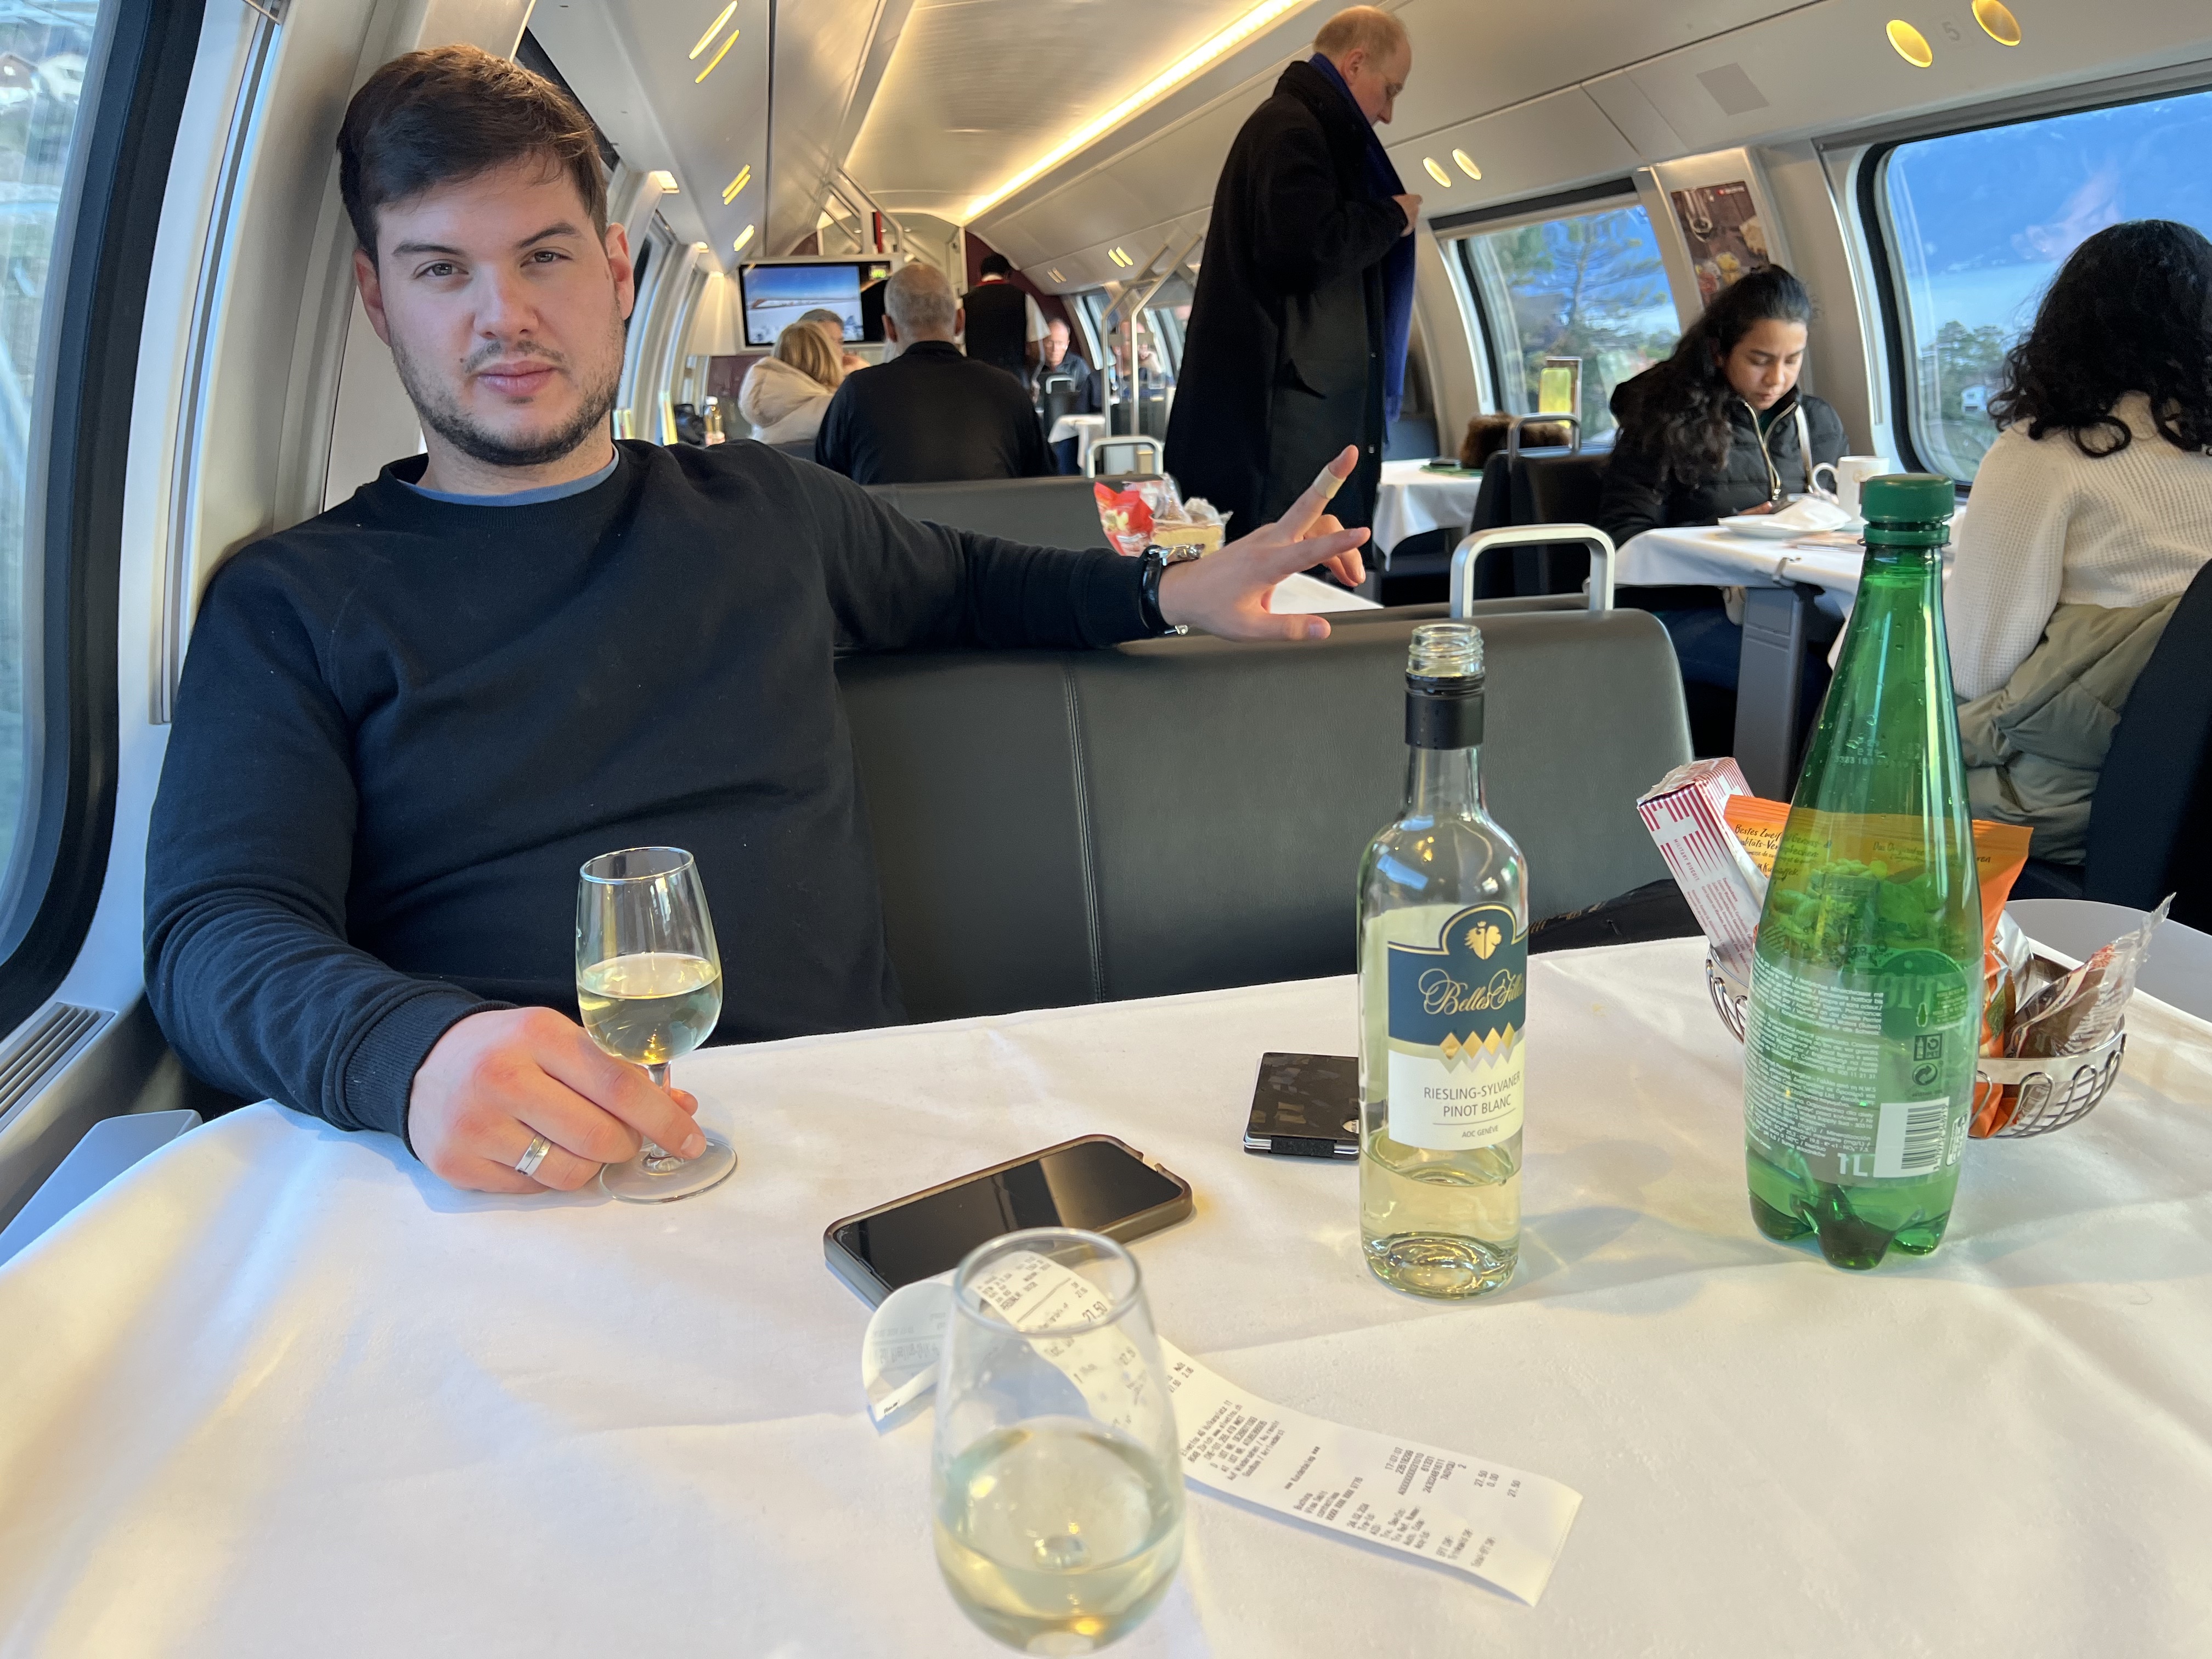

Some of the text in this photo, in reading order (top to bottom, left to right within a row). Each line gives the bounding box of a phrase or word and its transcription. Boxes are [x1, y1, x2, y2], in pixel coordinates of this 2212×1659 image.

[1735, 825, 1758, 836] Bestes
[1674, 839, 1700, 882] MILITARY BISCUIT
[1418, 968, 1491, 1015] Belles
[1424, 1071, 1520, 1100] RIESLING-SYLVANER
[1443, 1094, 1511, 1117] PINOT BLANC
[1477, 1125, 1499, 1136] GENÈVE
[1837, 1152, 1868, 1177] 1L
[1082, 1301, 1108, 1322] 27.50
[1474, 1470, 1488, 1487] 27.50
[1486, 1473, 1499, 1487] 0.00
[1507, 1480, 1521, 1498] 27.50
